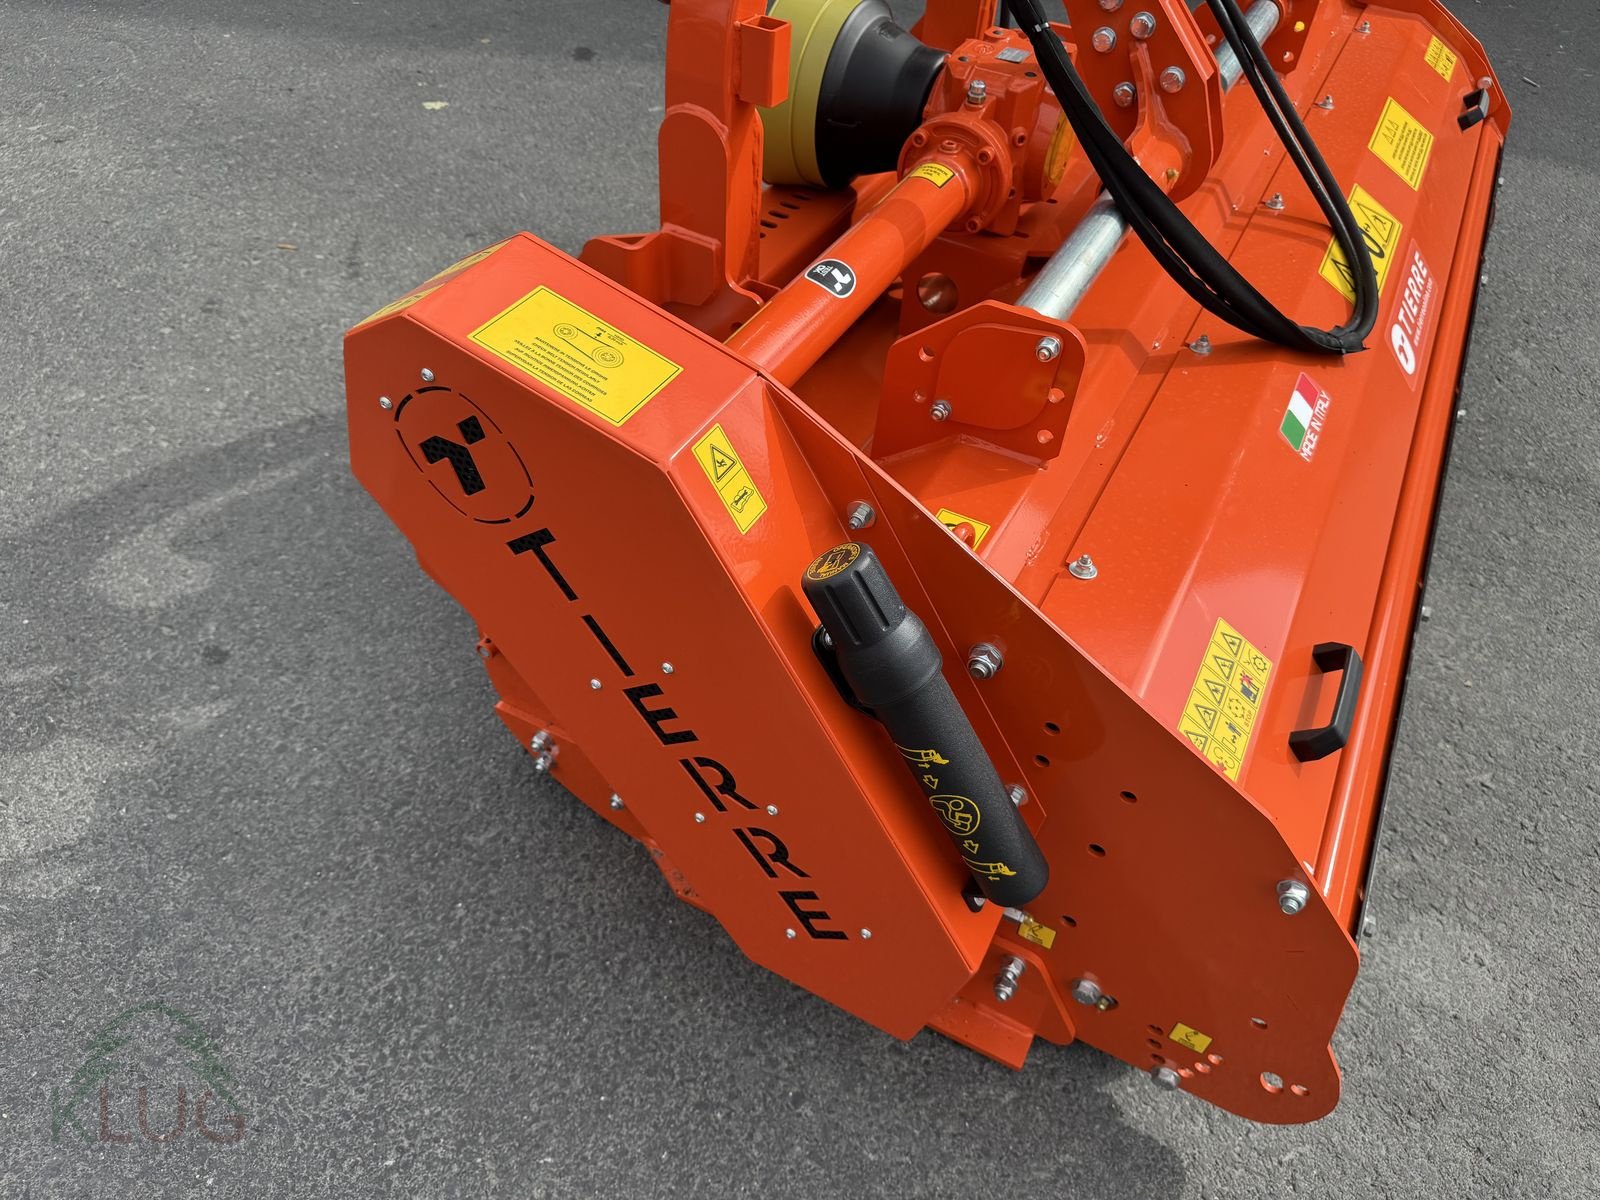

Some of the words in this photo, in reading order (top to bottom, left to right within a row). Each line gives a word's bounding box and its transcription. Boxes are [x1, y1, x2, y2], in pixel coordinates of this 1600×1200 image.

[1397, 250, 1428, 335] TIERRE
[532, 342, 547, 352] CHECK
[558, 357, 576, 369] TENSION
[556, 364, 574, 375] TENSION
[538, 369, 557, 381] TENSION
[1314, 390, 1331, 421] ITALY
[1310, 416, 1323, 432] IN
[1299, 429, 1318, 463] MADE
[506, 527, 849, 942] TIERRE
